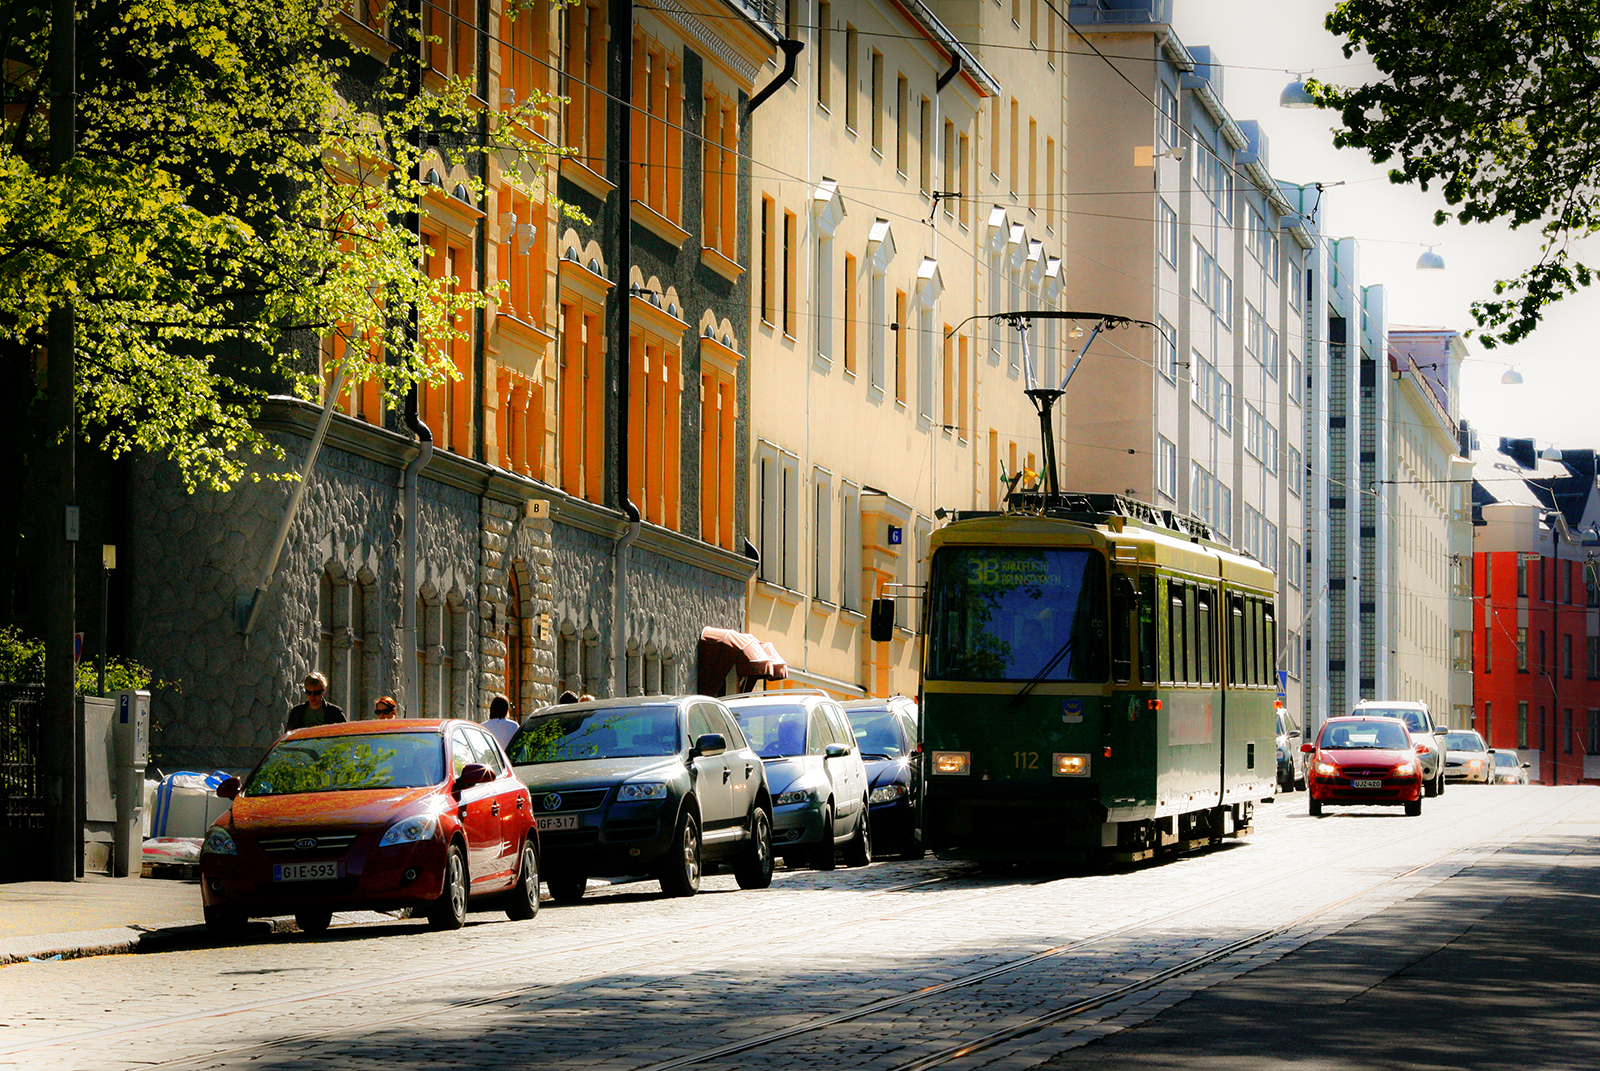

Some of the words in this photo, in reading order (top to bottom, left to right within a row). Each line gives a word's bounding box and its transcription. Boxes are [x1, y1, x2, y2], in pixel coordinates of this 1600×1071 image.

[533, 503, 539, 513] B
[892, 530, 899, 542] 6
[967, 559, 999, 584] 3B
[121, 695, 128, 706] 2
[1013, 751, 1039, 769] 112
[283, 864, 335, 878] GIE-593
